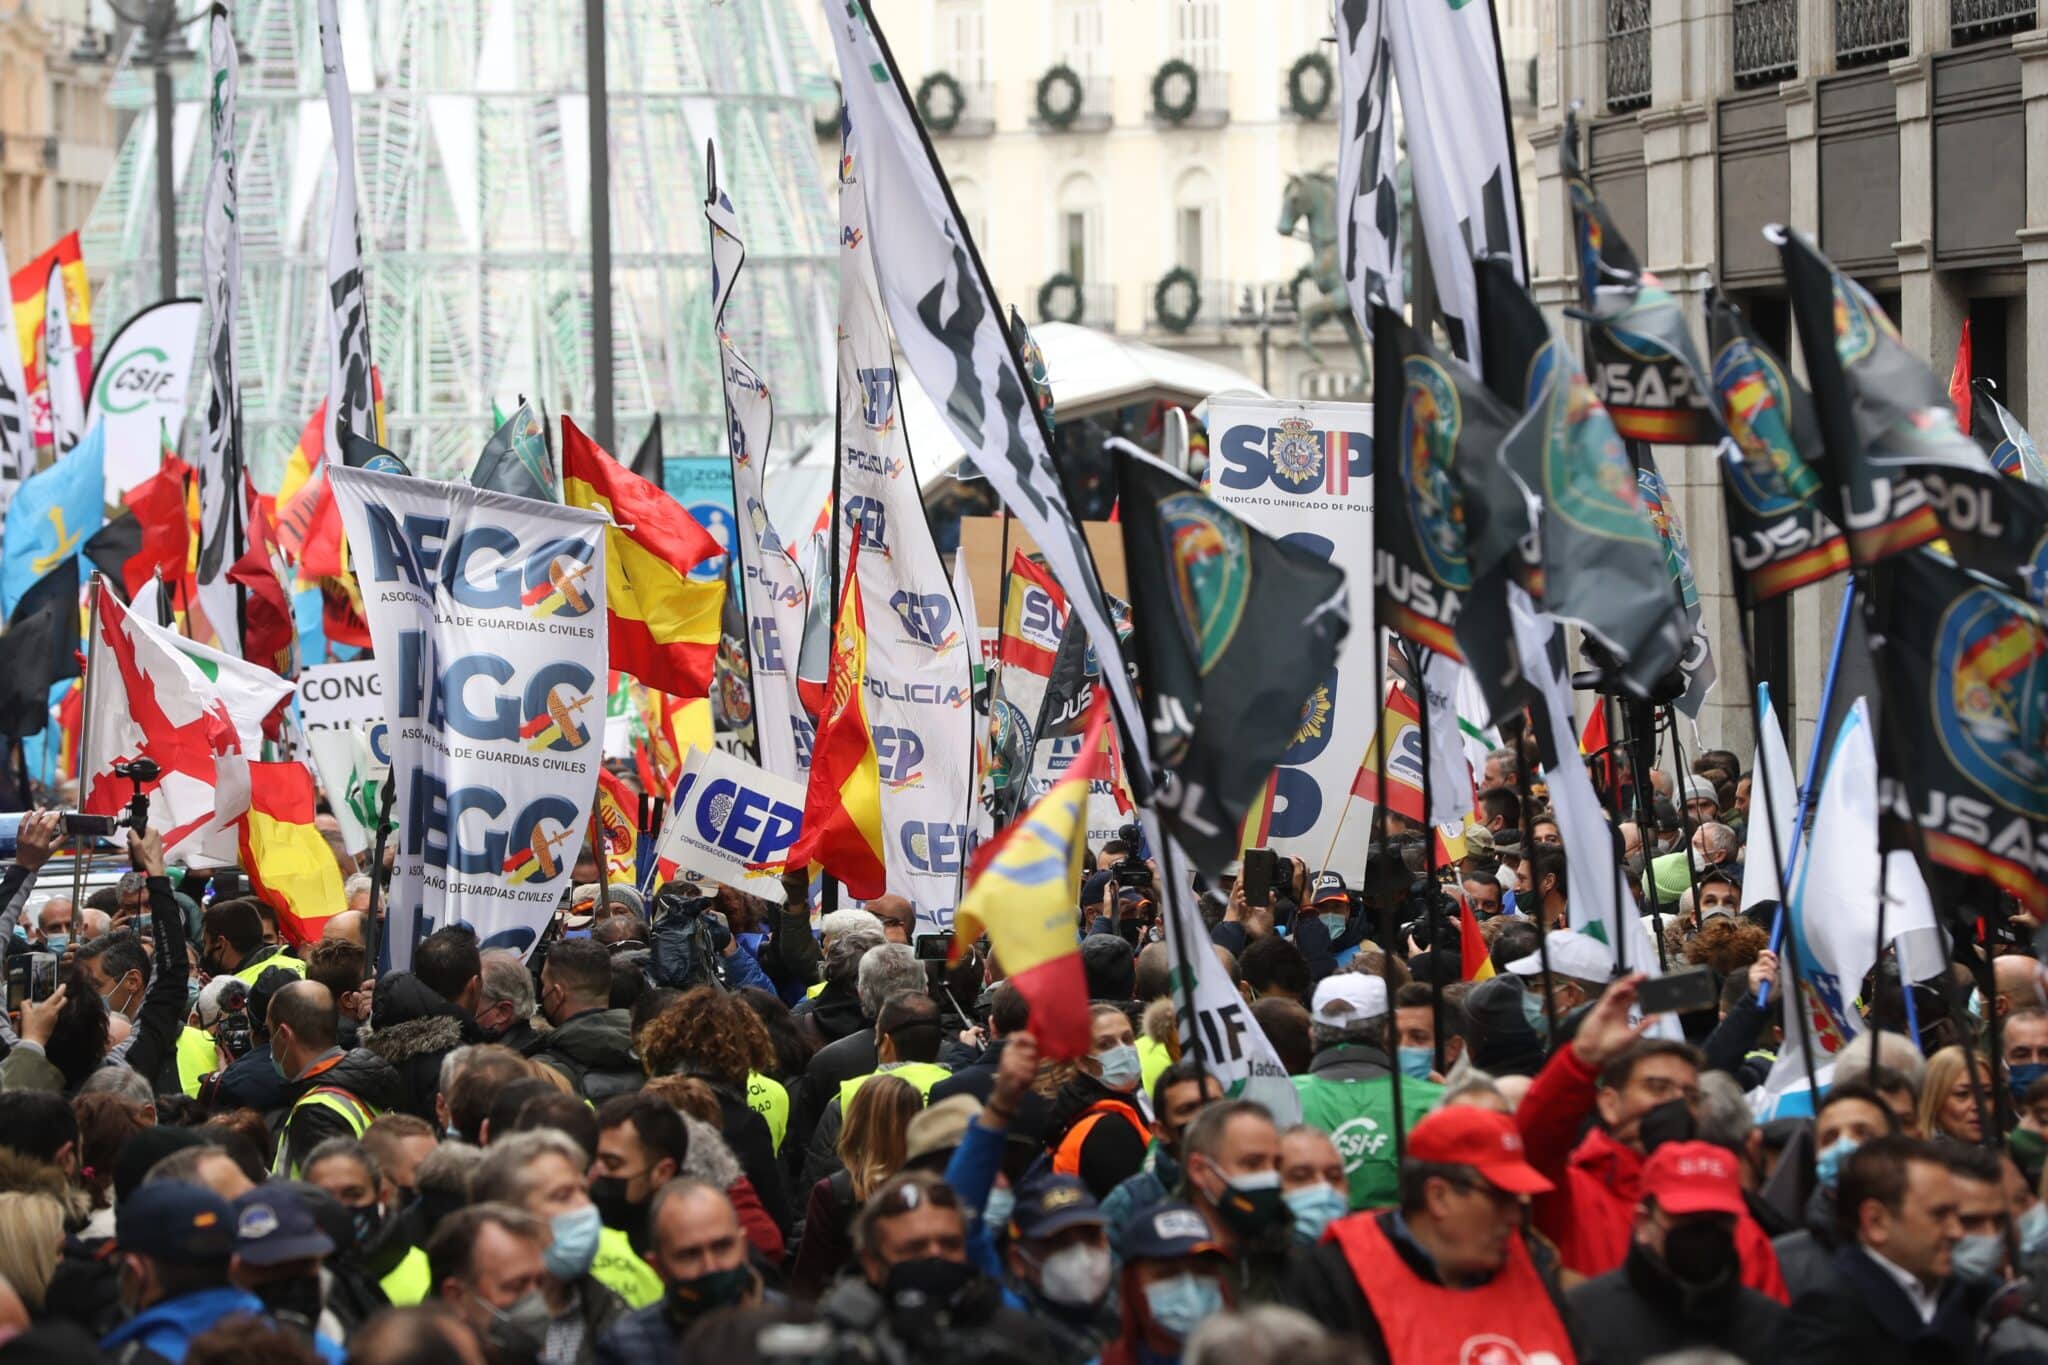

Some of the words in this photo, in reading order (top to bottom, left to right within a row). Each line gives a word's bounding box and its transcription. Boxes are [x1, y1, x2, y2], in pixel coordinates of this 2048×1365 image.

[1219, 424, 1375, 496] SUP
[1273, 498, 1329, 511] UNIFICADO
[1331, 503, 1344, 511] DE
[364, 502, 595, 618] AEGC
[456, 616, 473, 628] DE
[478, 618, 546, 634] GUARDIAS
[549, 624, 594, 639] CIVILES
[889, 590, 951, 644] CEP
[455, 747, 473, 760] DE
[475, 750, 540, 768] GUARDIAS
[542, 760, 587, 774] CIVILES
[696, 778, 805, 863] CEP
[517, 890, 554, 903] CIVILES
